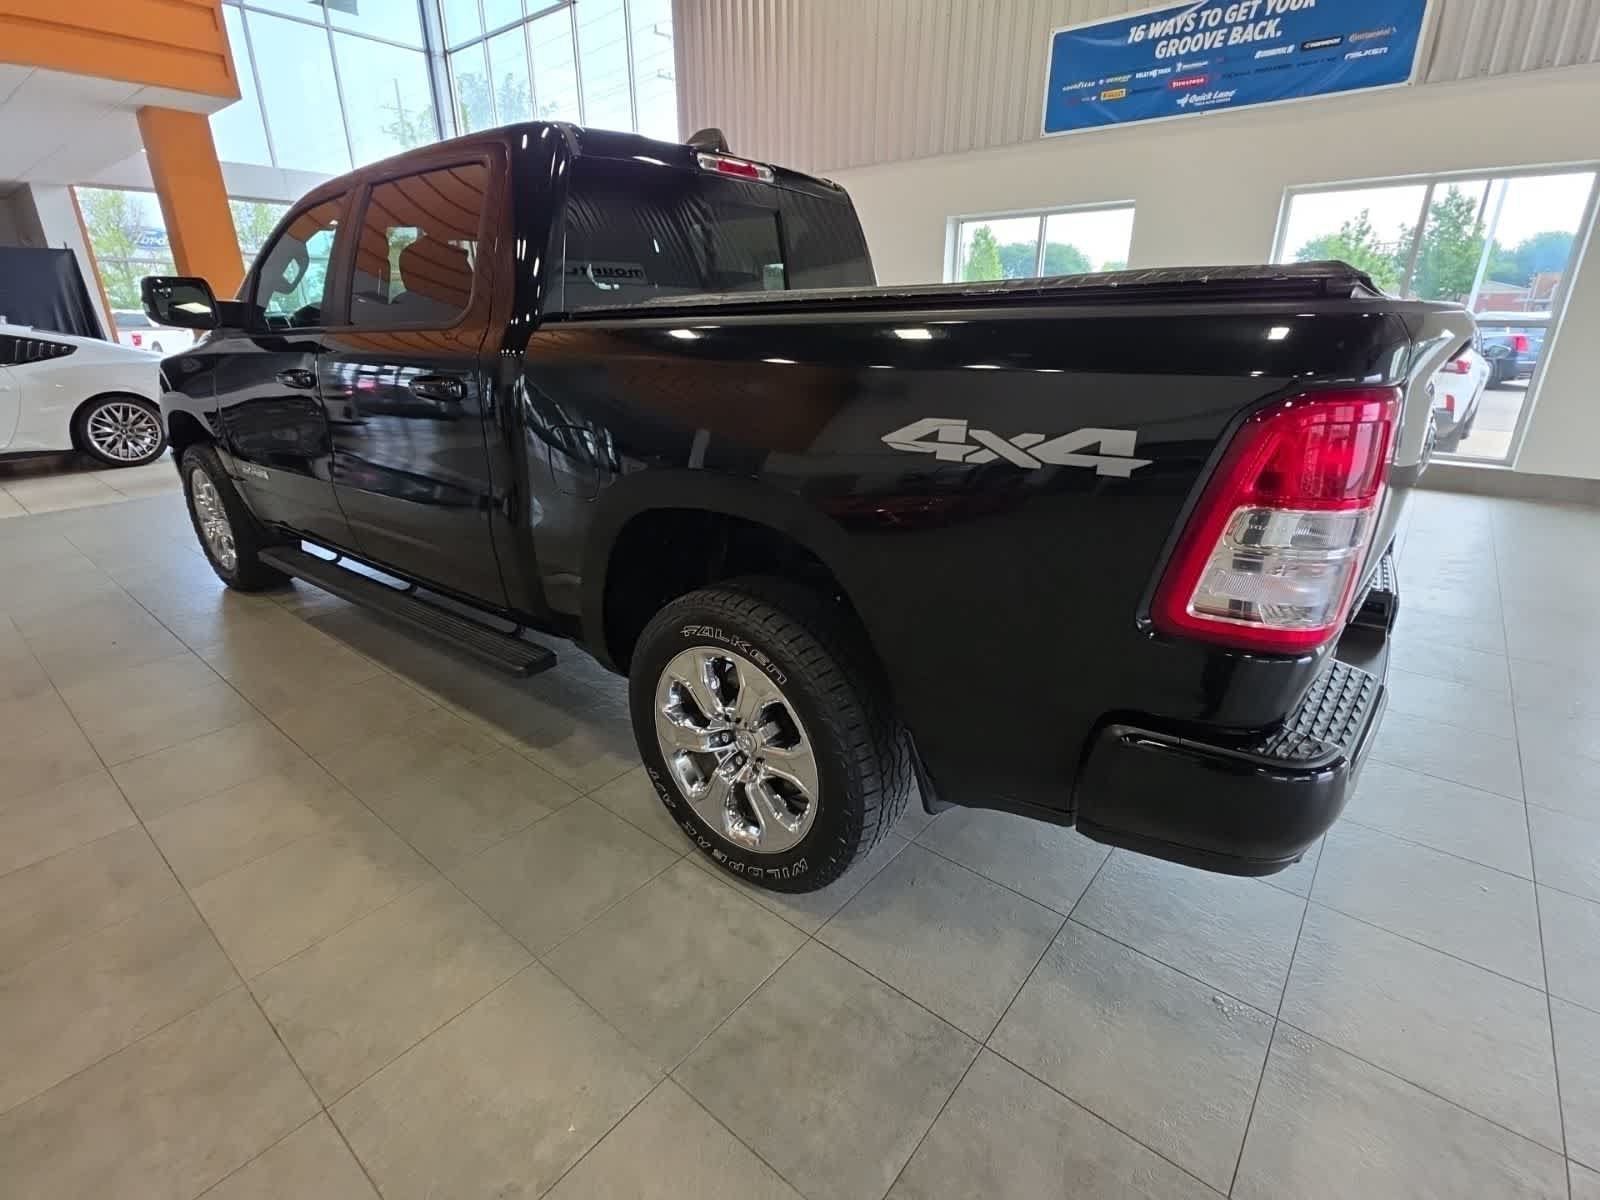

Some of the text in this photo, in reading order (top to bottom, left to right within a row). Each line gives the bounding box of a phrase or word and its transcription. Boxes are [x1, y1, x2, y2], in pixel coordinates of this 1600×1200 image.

[1127, 24, 1146, 44] 16
[1147, 11, 1198, 39] WAYS
[1199, 7, 1222, 30] TO
[1224, 0, 1263, 24] GET
[1155, 29, 1230, 59] GROOVE
[1227, 17, 1283, 46] BACK.
[680, 625, 788, 685] FALKEN
